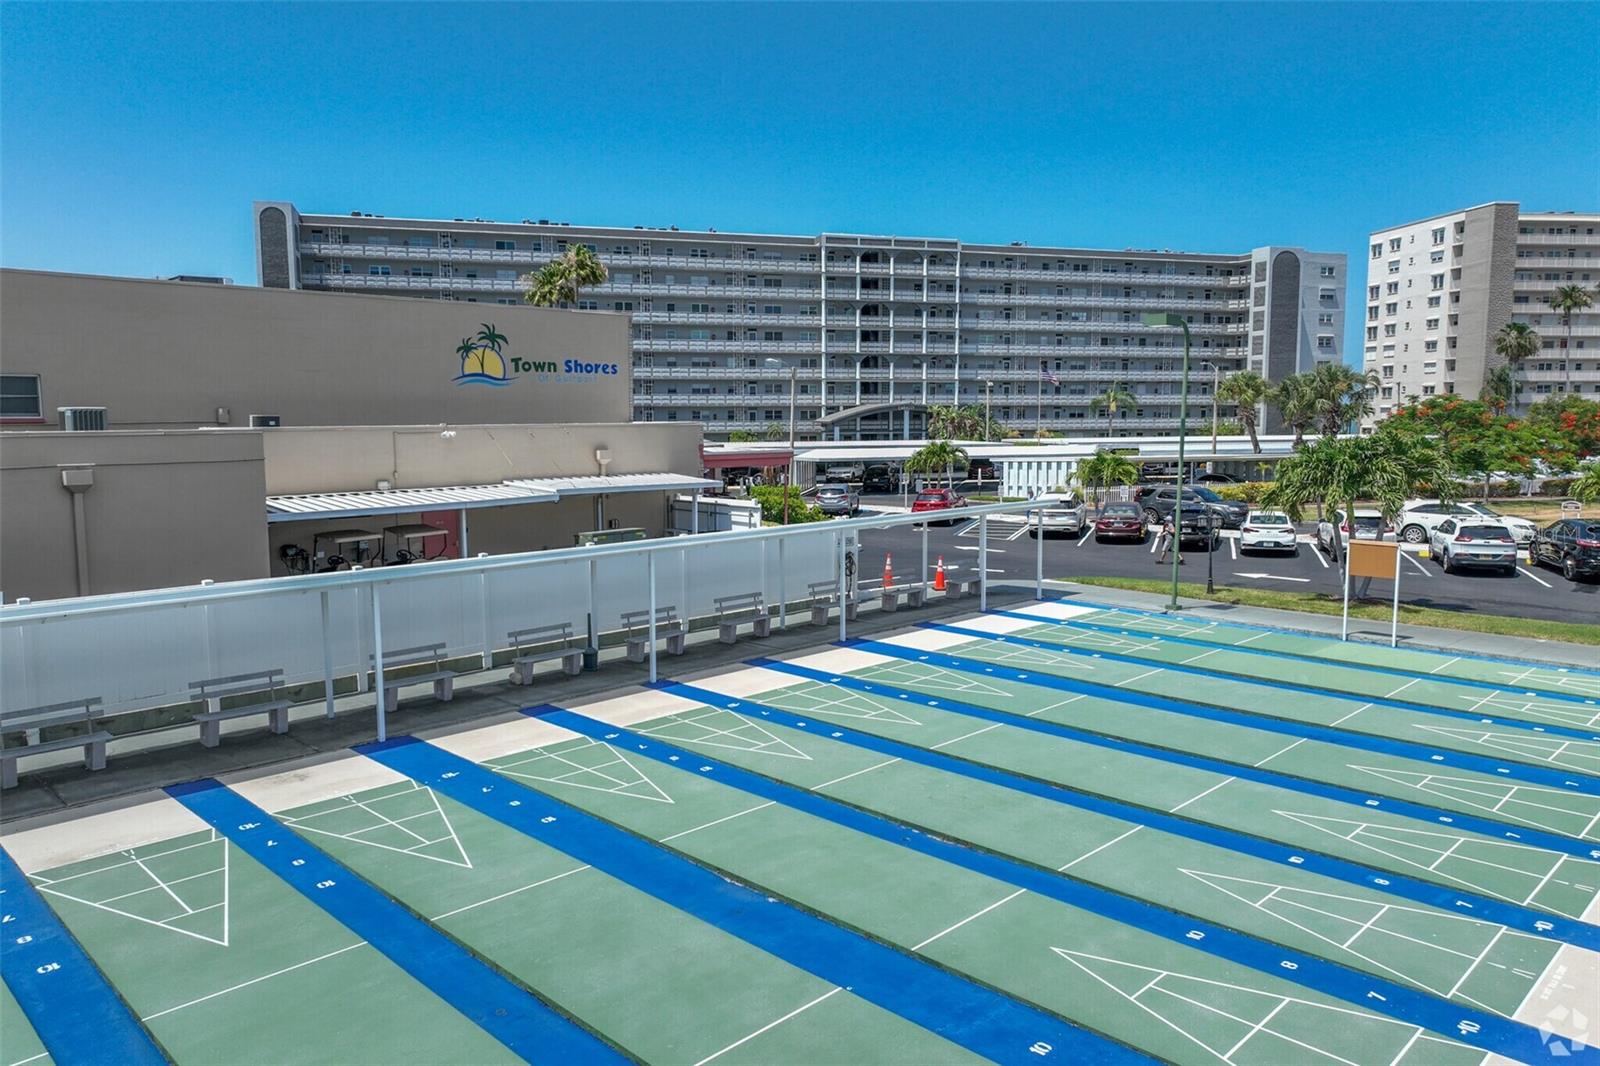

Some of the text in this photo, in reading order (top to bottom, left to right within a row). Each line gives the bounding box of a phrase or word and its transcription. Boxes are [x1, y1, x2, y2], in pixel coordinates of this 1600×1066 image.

[510, 357, 618, 375] Town Shores
[1438, 815, 1454, 823] 8
[1374, 878, 1390, 886] 8
[1455, 900, 1473, 909] 7
[1186, 930, 1206, 940] 10
[1281, 960, 1298, 970] 8
[1366, 991, 1387, 1002] 7
[1456, 1019, 1481, 1035] -10
[1029, 1042, 1053, 1056] 10
